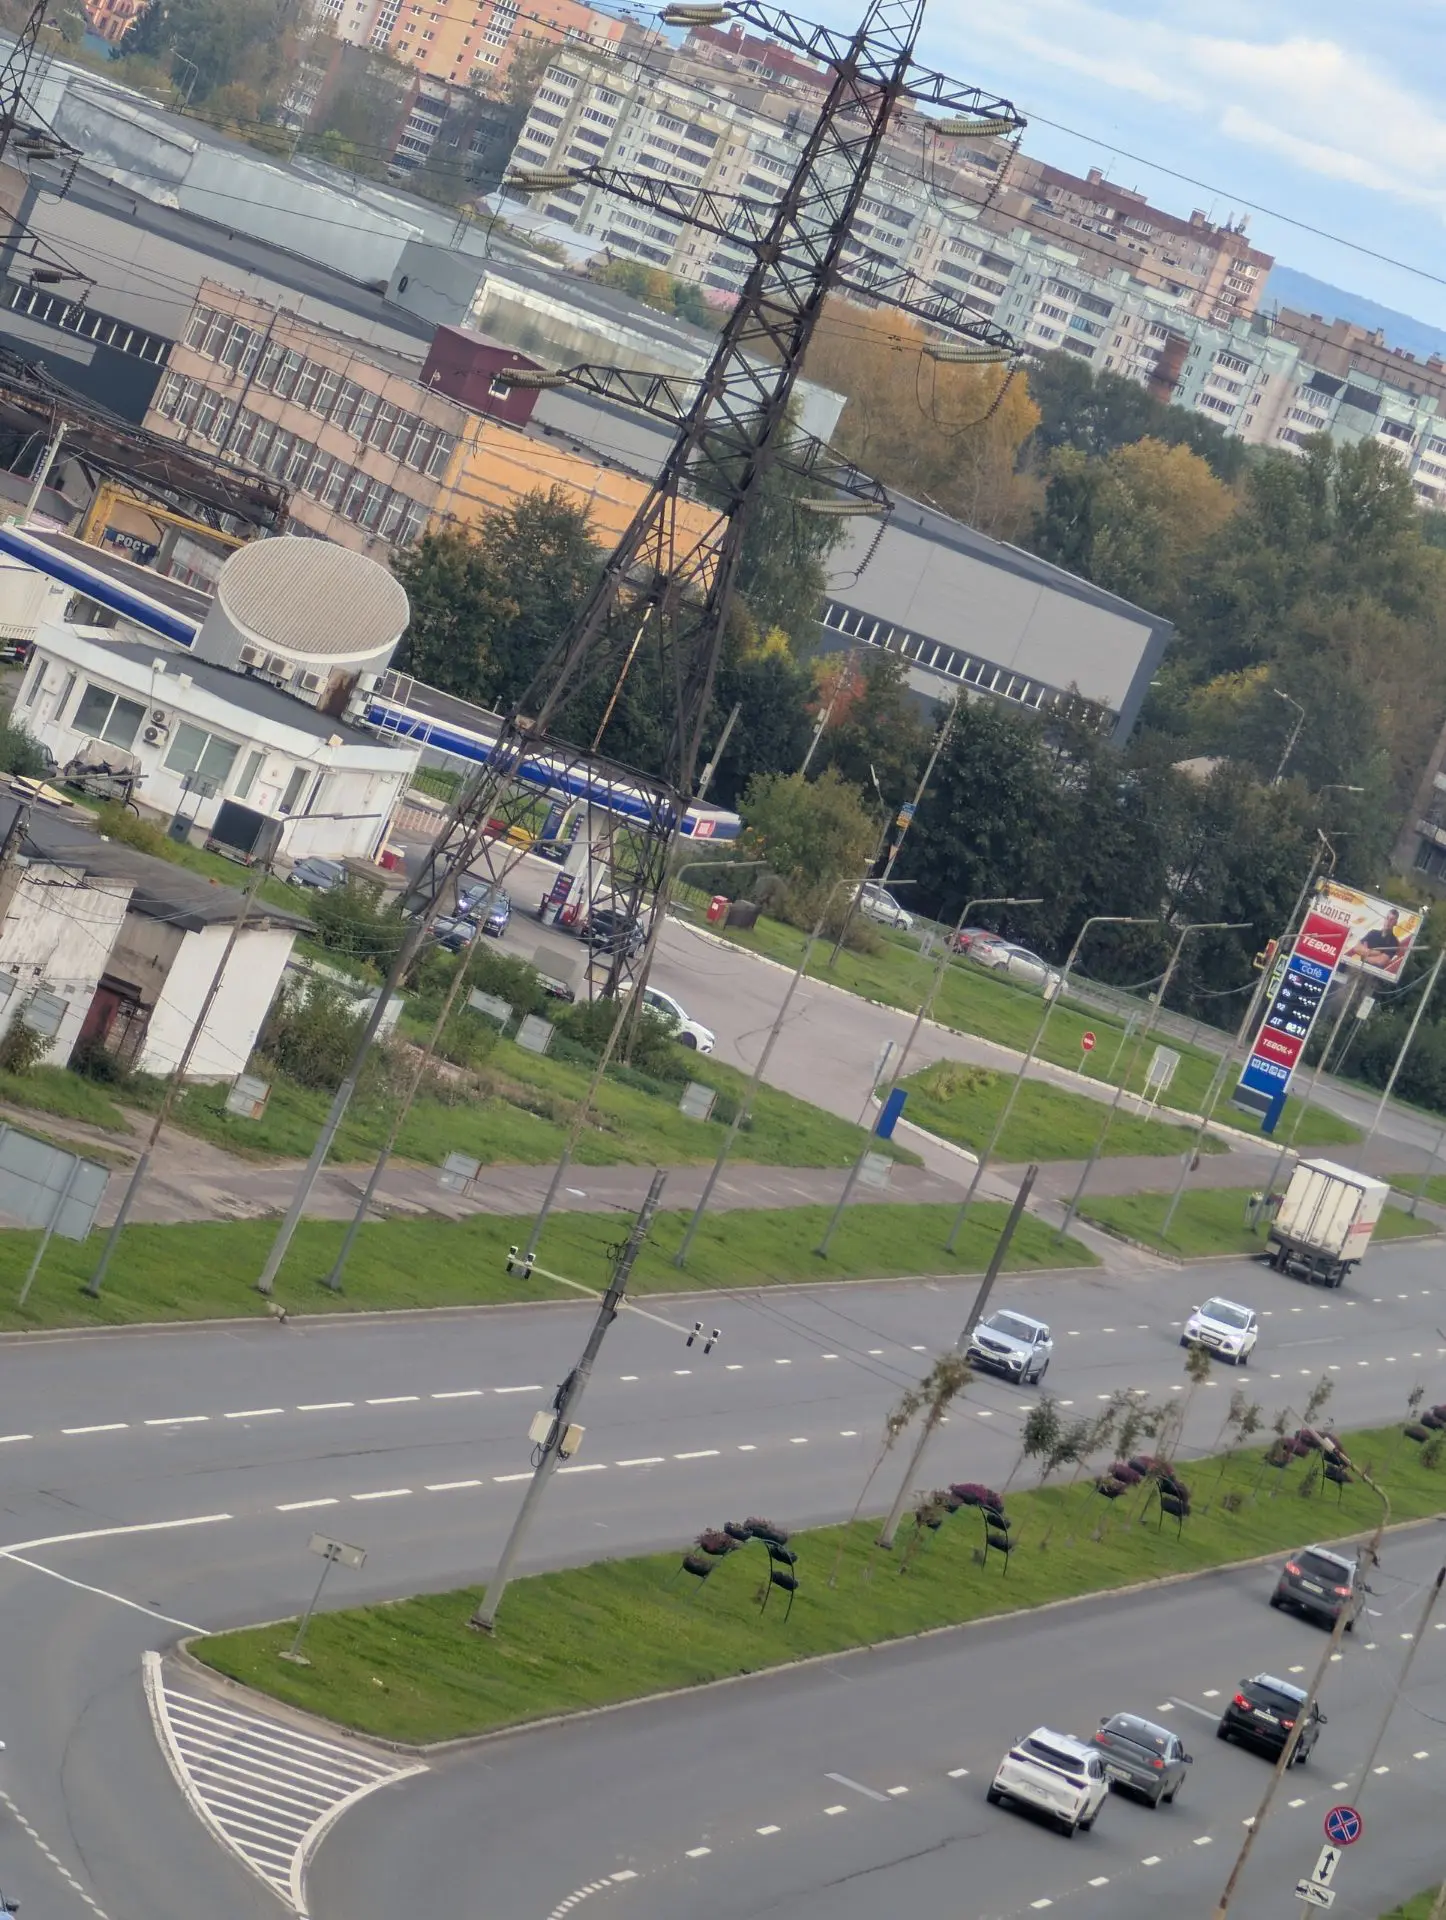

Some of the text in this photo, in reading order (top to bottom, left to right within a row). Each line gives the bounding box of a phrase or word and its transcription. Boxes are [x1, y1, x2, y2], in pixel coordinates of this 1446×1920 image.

[115, 533, 150, 555] РОСТ
[1302, 935, 1337, 956] TEBOIL
[1270, 1016, 1283, 1025] ДТ
